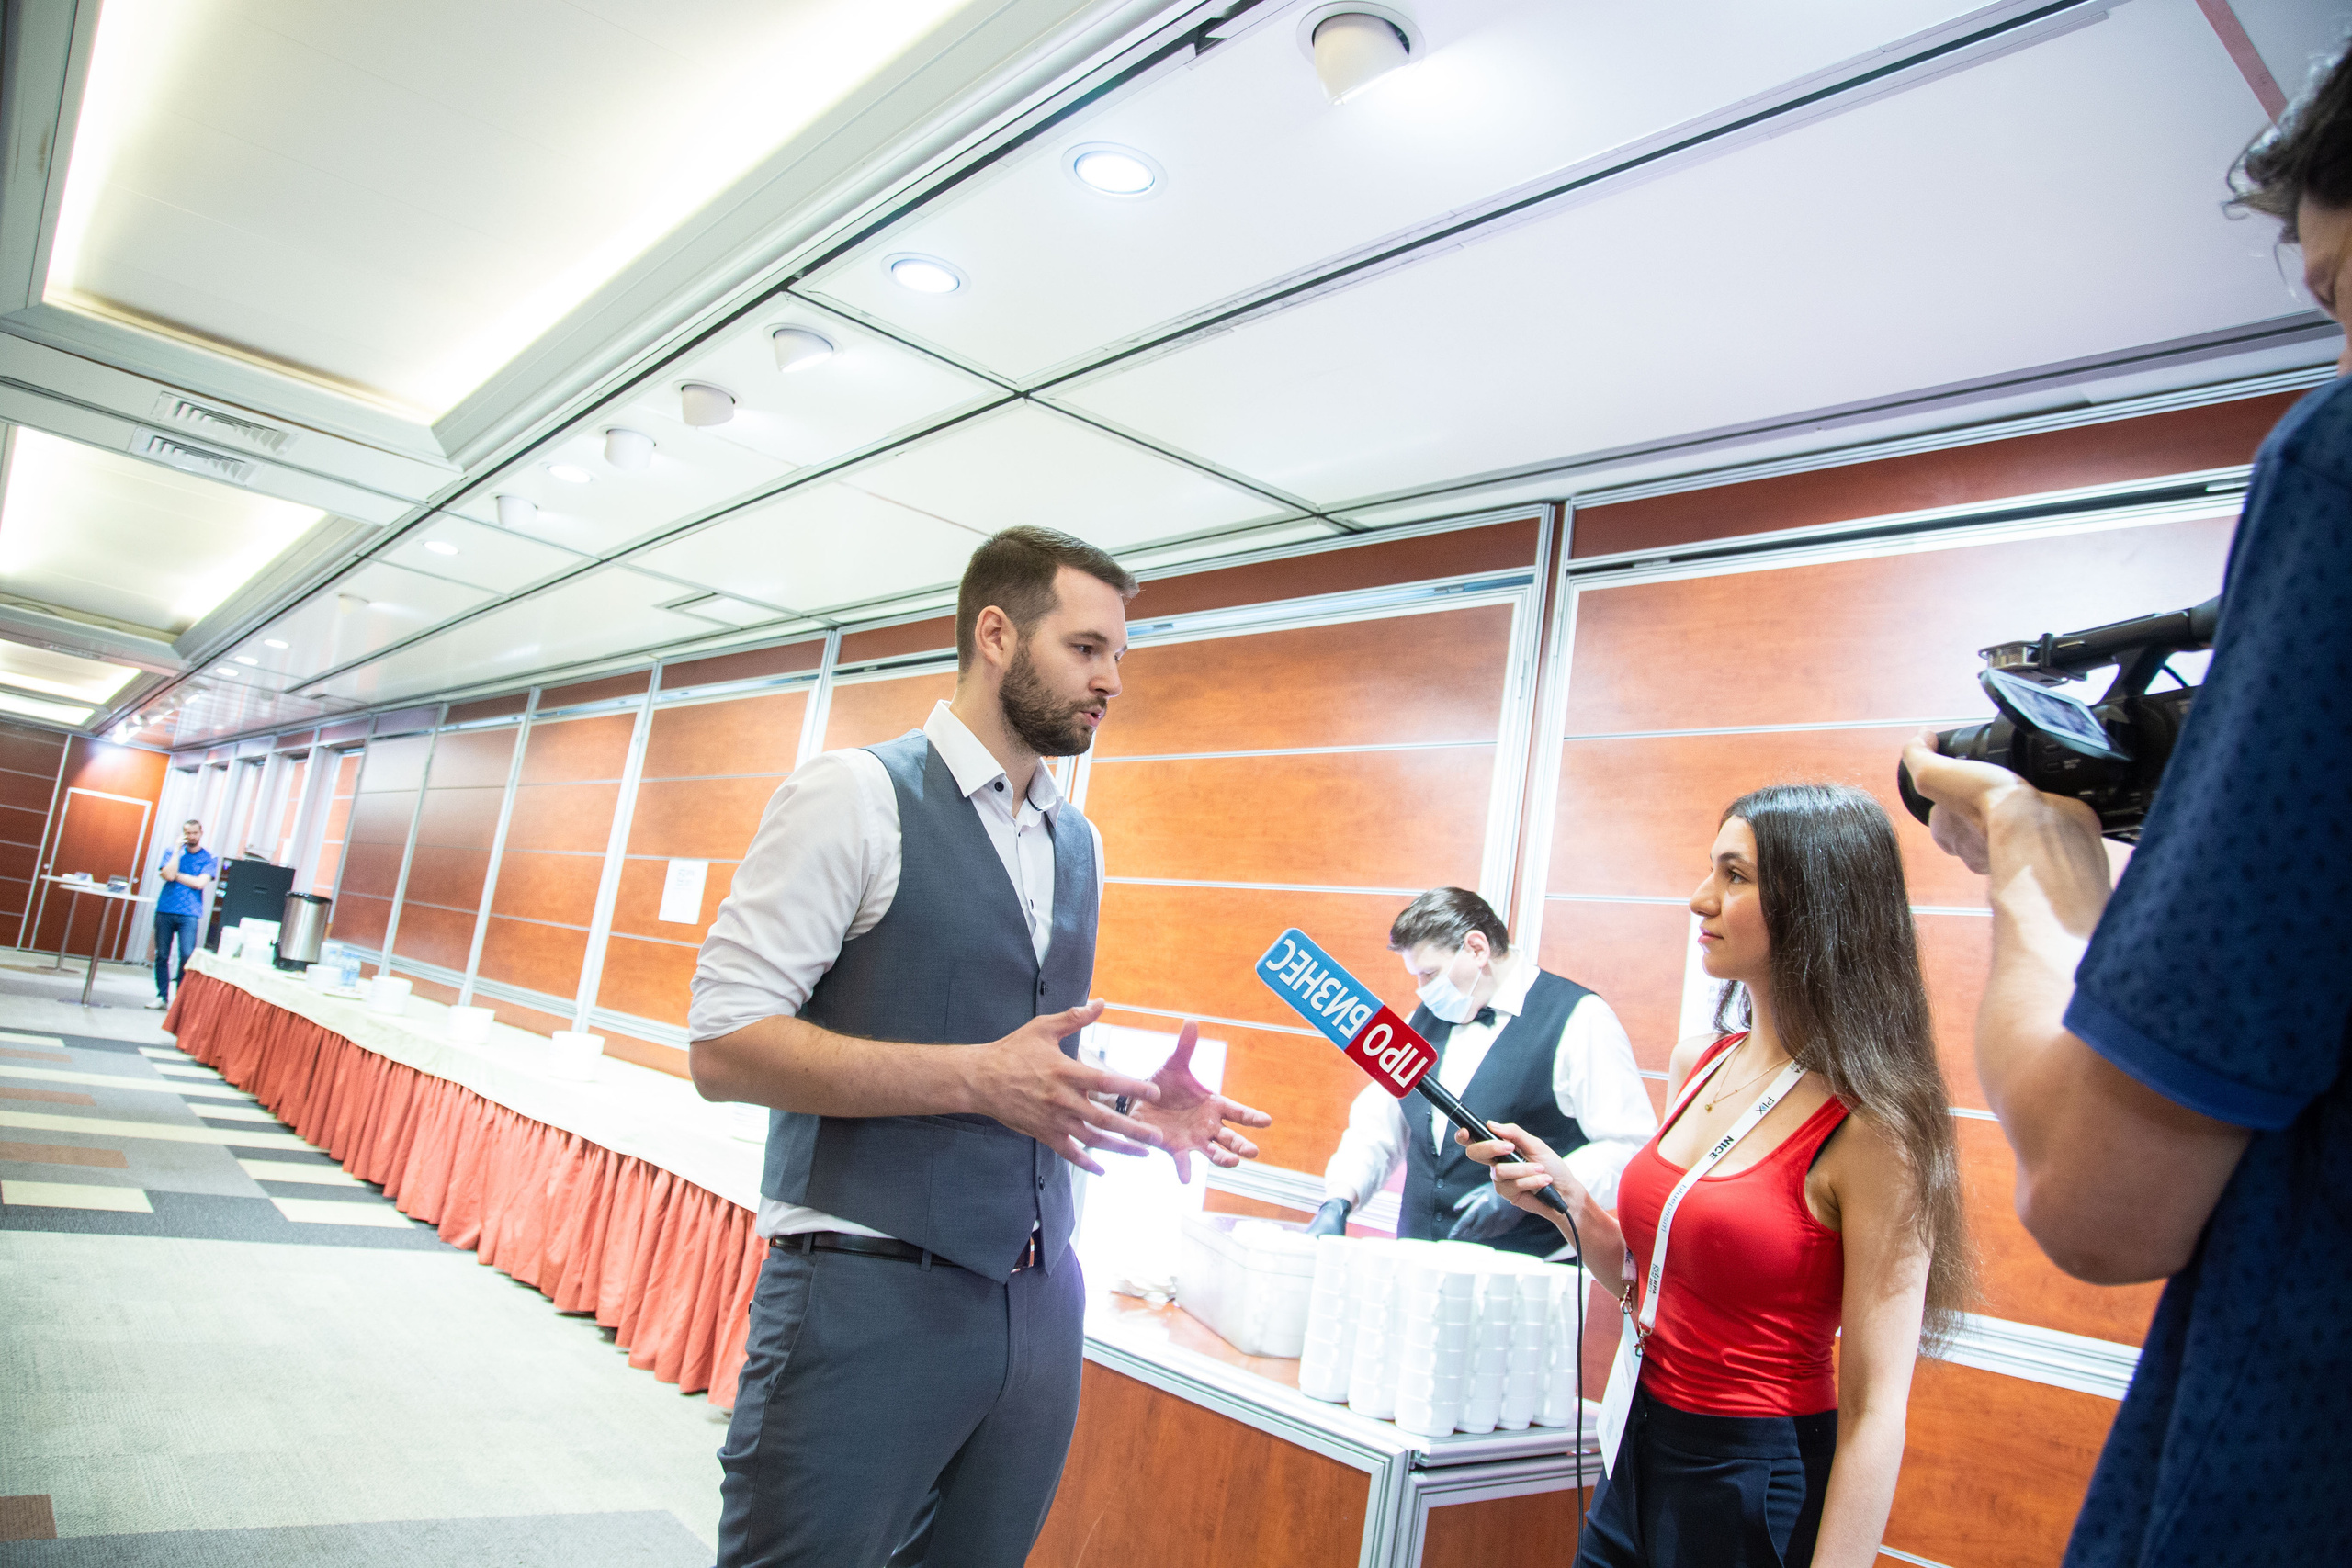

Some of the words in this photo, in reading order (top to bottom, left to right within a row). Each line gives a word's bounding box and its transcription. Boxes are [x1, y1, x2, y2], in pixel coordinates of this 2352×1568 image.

[1265, 938, 1374, 1040] БИЗНЕС
[1362, 1023, 1429, 1089] ПРО
[1755, 1096, 1775, 1115] PIX
[1708, 1135, 1735, 1160] NICE
